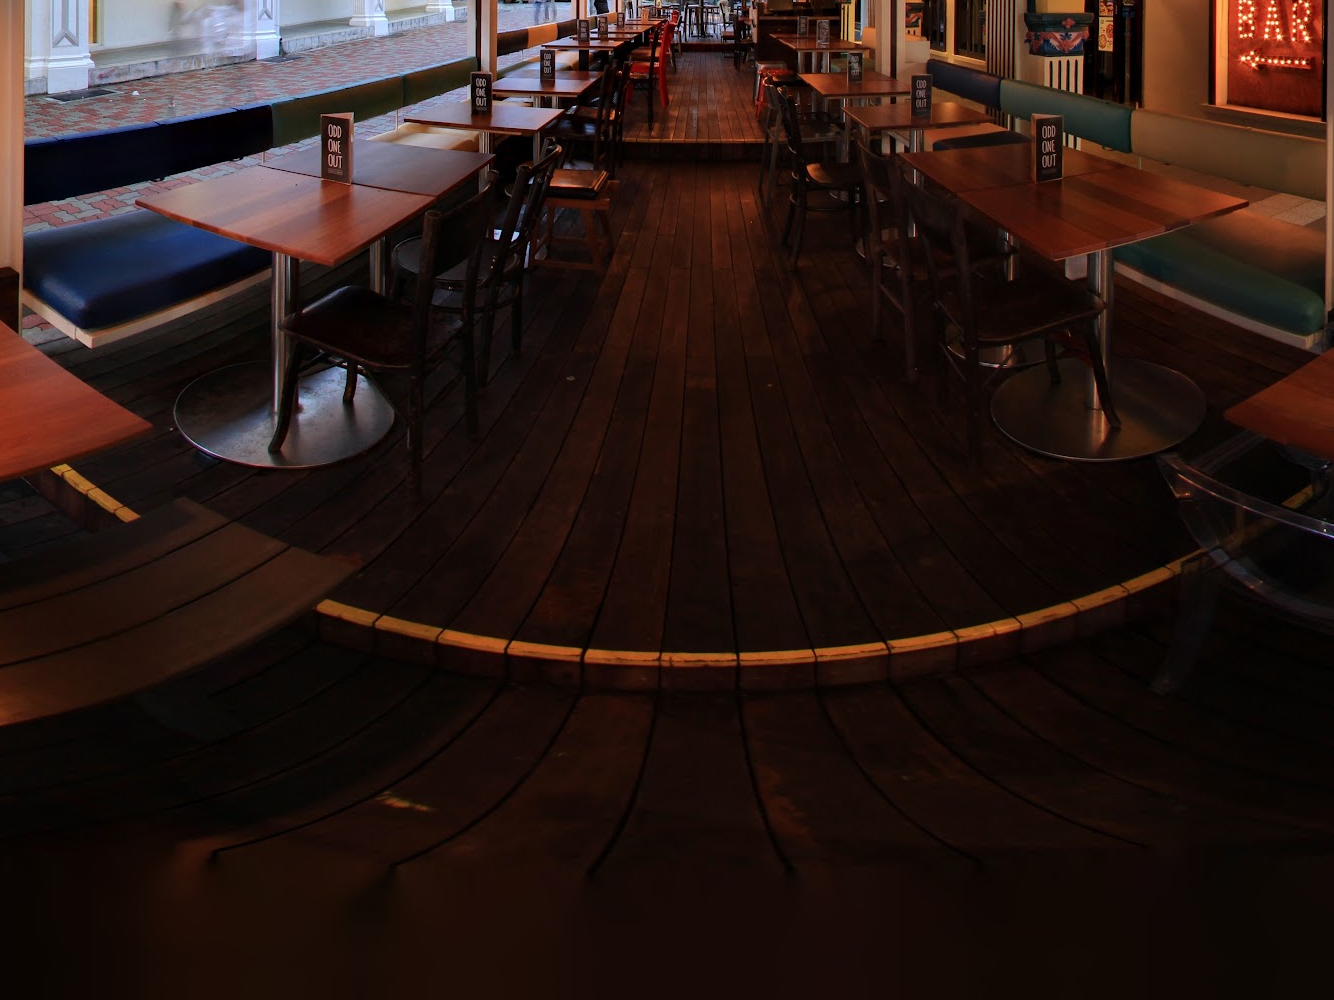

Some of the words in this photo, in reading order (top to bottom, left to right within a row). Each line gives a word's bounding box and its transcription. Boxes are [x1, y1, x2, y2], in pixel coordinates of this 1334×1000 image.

[476, 78, 486, 87] ODD
[916, 80, 927, 88] ODD
[476, 88, 486, 97] ONE
[916, 90, 926, 98] ONE
[476, 97, 487, 106] OUT
[916, 99, 927, 107] OUT
[328, 124, 342, 138] ODD
[1042, 126, 1056, 138] ODD
[328, 139, 342, 153] ONE
[1042, 140, 1055, 153] ONE
[328, 153, 343, 168] OUT
[1042, 154, 1057, 168] OUT
